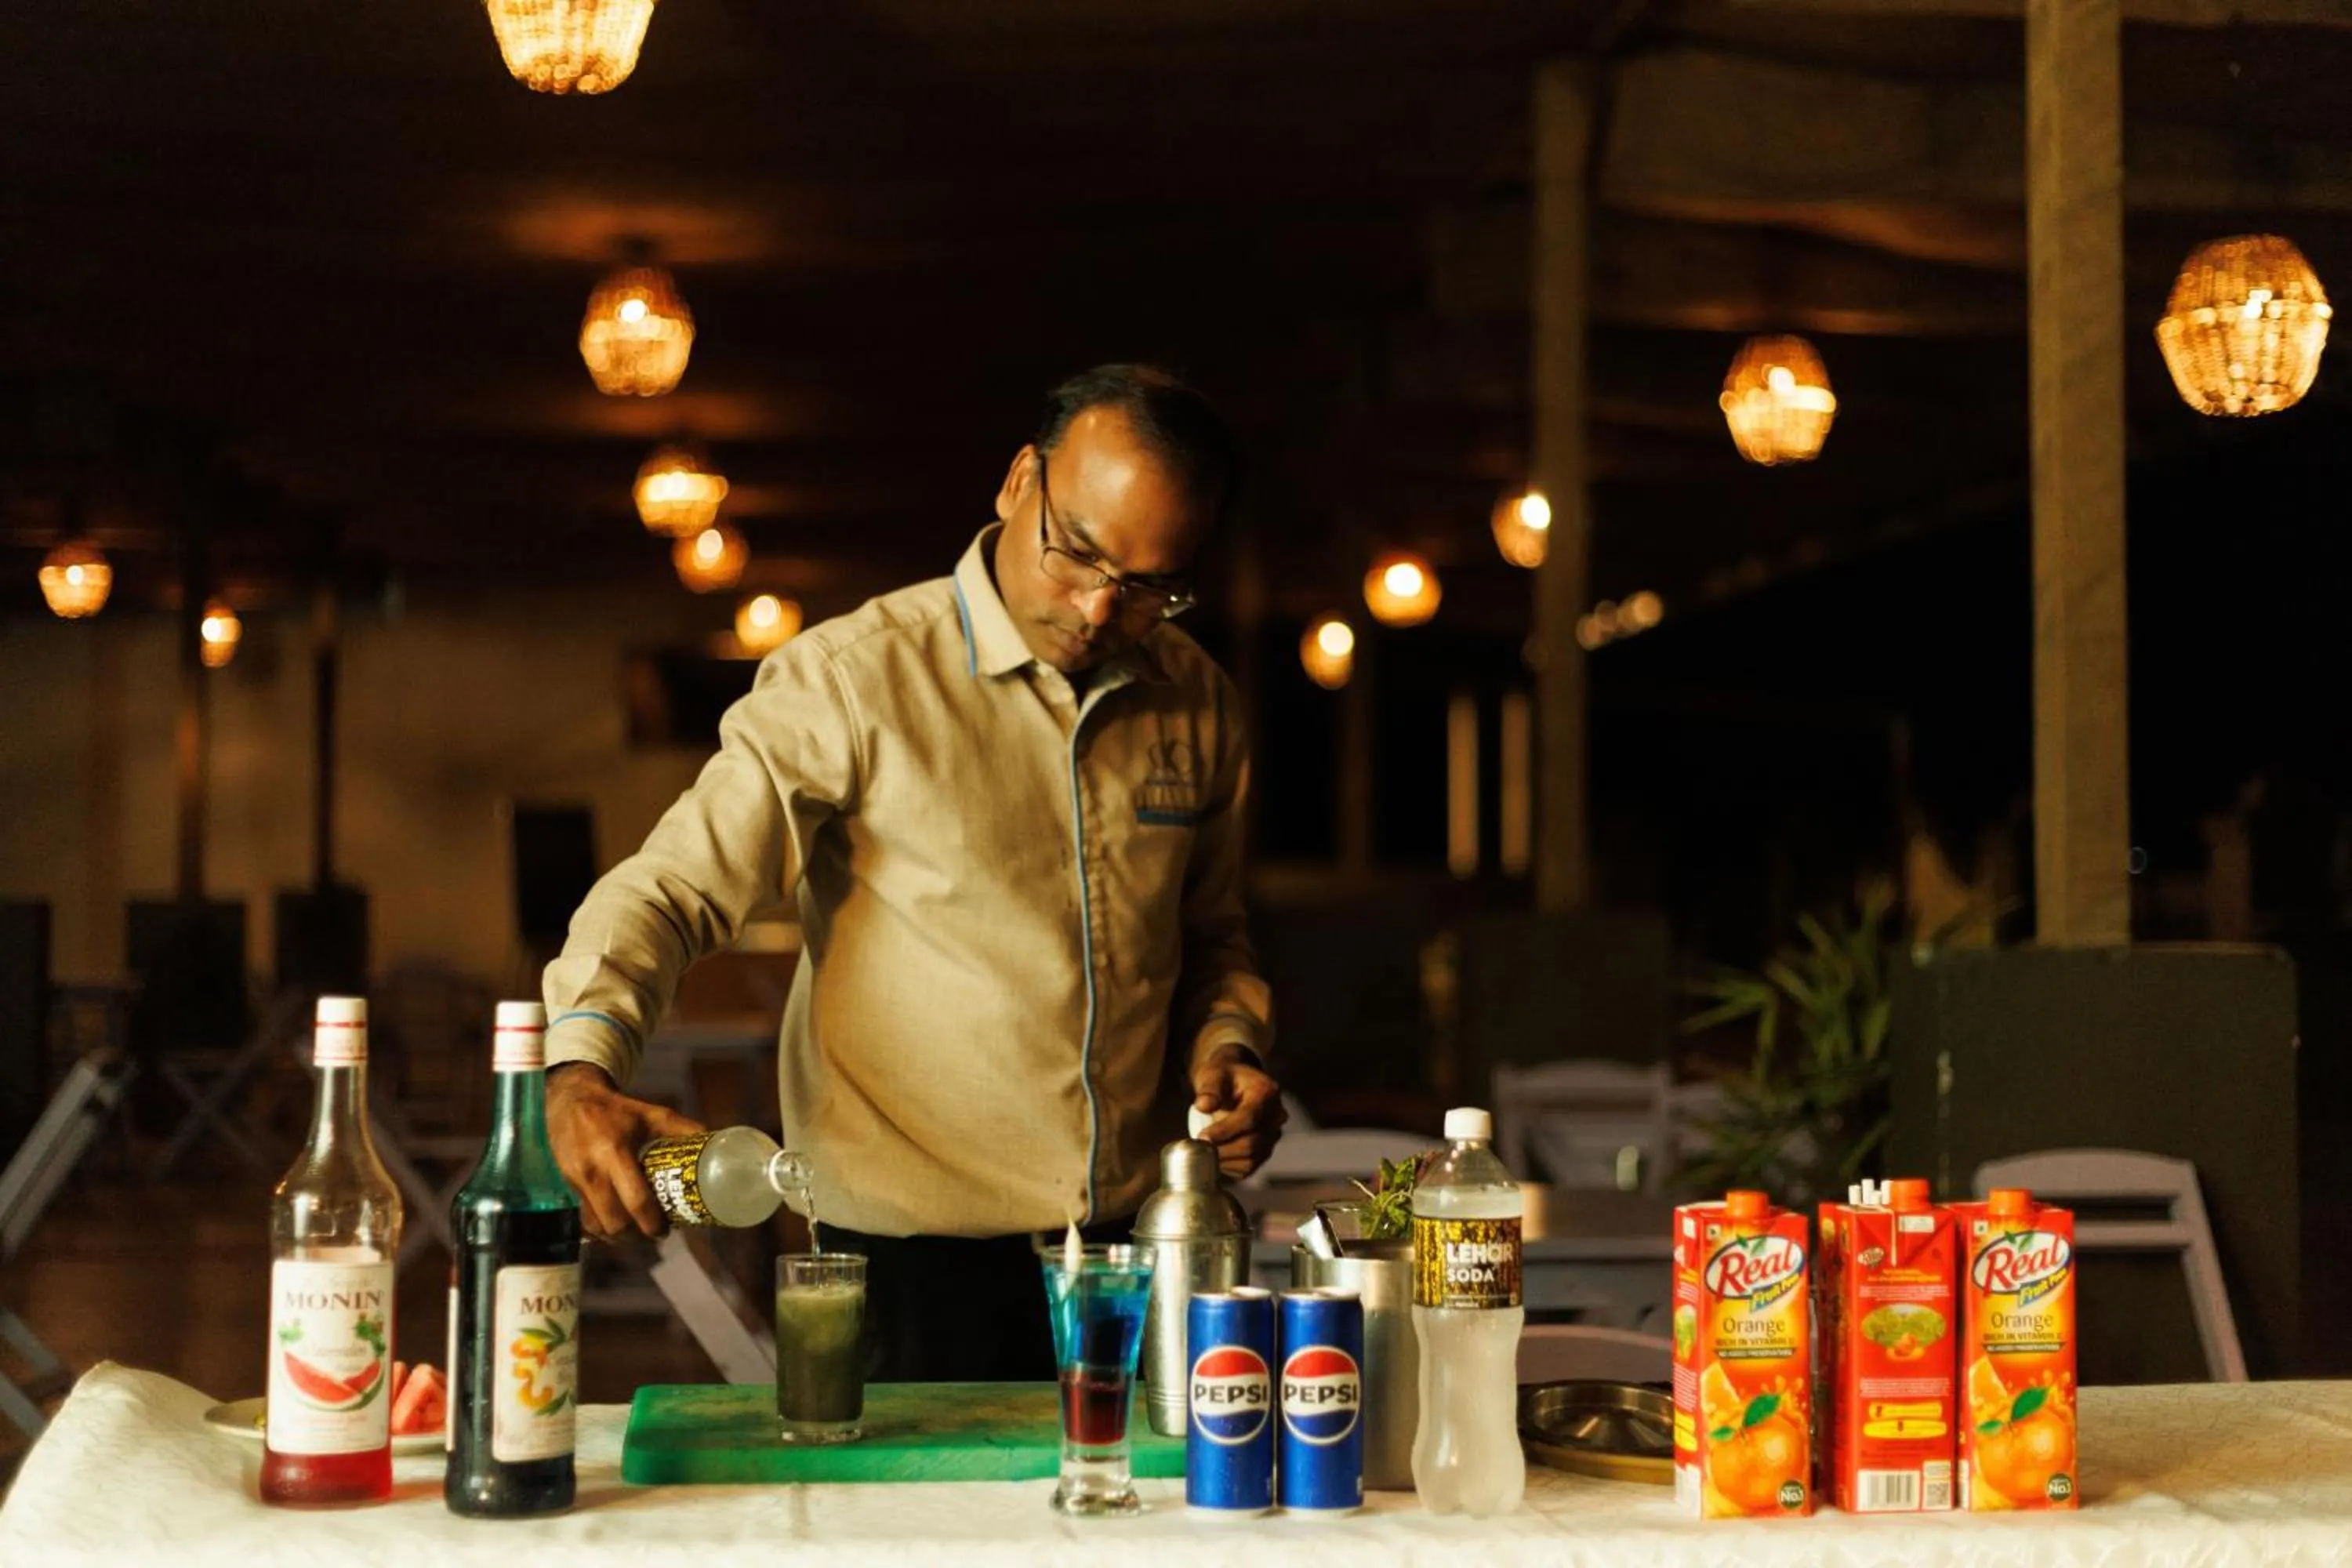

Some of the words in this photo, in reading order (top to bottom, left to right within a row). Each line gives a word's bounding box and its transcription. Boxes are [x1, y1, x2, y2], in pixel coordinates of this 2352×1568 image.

[1447, 1268, 1494, 1282] SODA
[1716, 1240, 1793, 1303] Real
[1983, 1234, 2060, 1298] Real
[285, 1290, 383, 1310] MONIN
[1722, 1316, 1785, 1337] Orange
[1991, 1312, 2053, 1331] Orange
[1195, 1384, 1268, 1403] PEPSI
[1284, 1384, 1357, 1403] PEPSI
